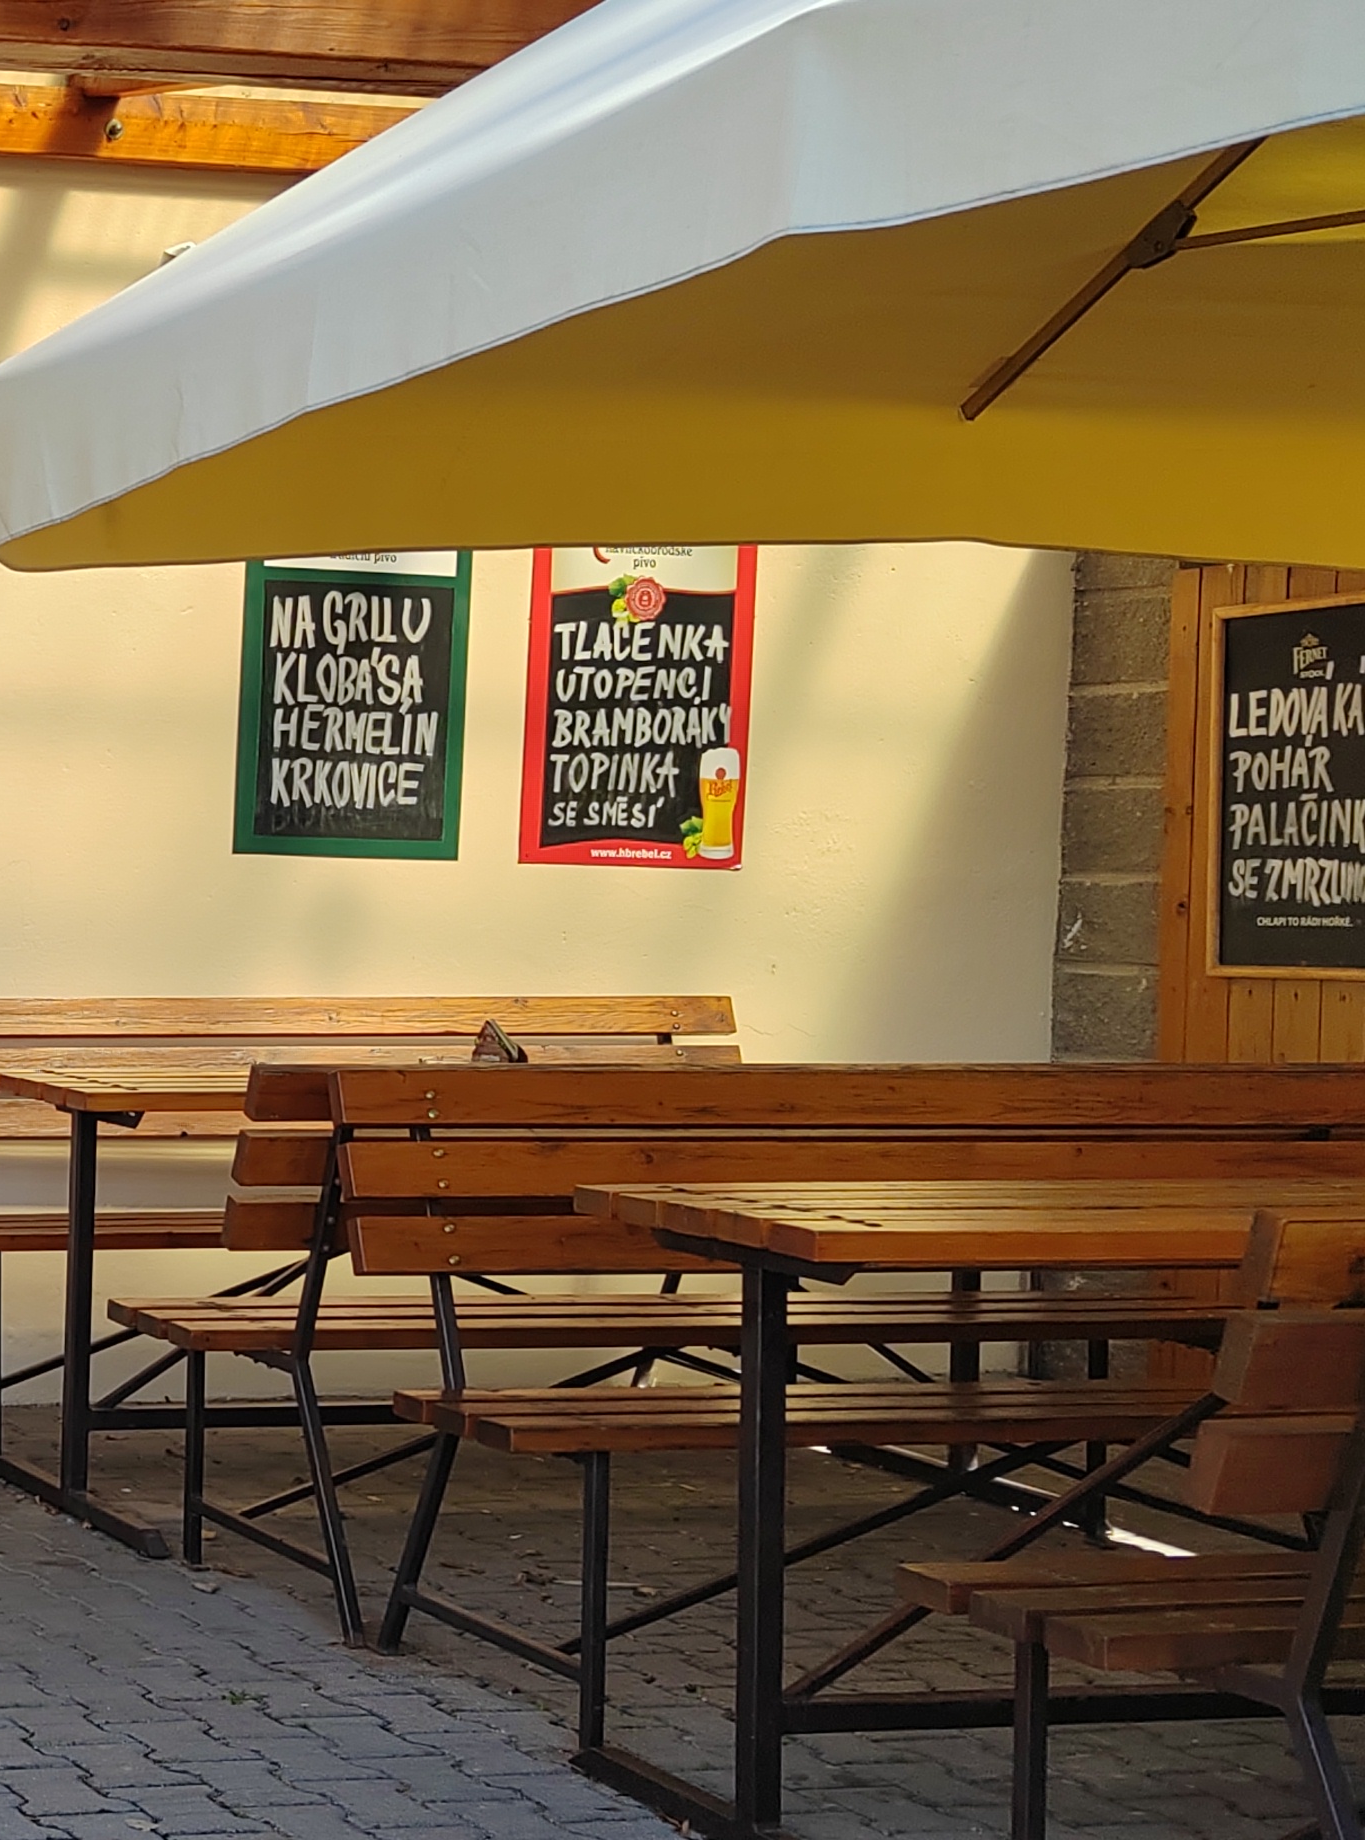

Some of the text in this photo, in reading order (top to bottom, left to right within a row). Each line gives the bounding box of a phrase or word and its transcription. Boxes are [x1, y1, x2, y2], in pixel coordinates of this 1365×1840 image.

[270, 590, 432, 655] NA GRILU
[1292, 646, 1328, 675] FERNET
[555, 665, 712, 701] UTOPENCI
[551, 697, 731, 748] BRAMBORÁKY
[270, 757, 424, 809] KRKOVICE
[550, 751, 680, 798] TOPINKA
[1228, 734, 1335, 793] POHÁR
[547, 796, 665, 828] SE SMĚSÍ
[590, 848, 672, 859] www.hbrebel.cz
[1228, 858, 1262, 899] SE
[1287, 916, 1299, 927] TO
